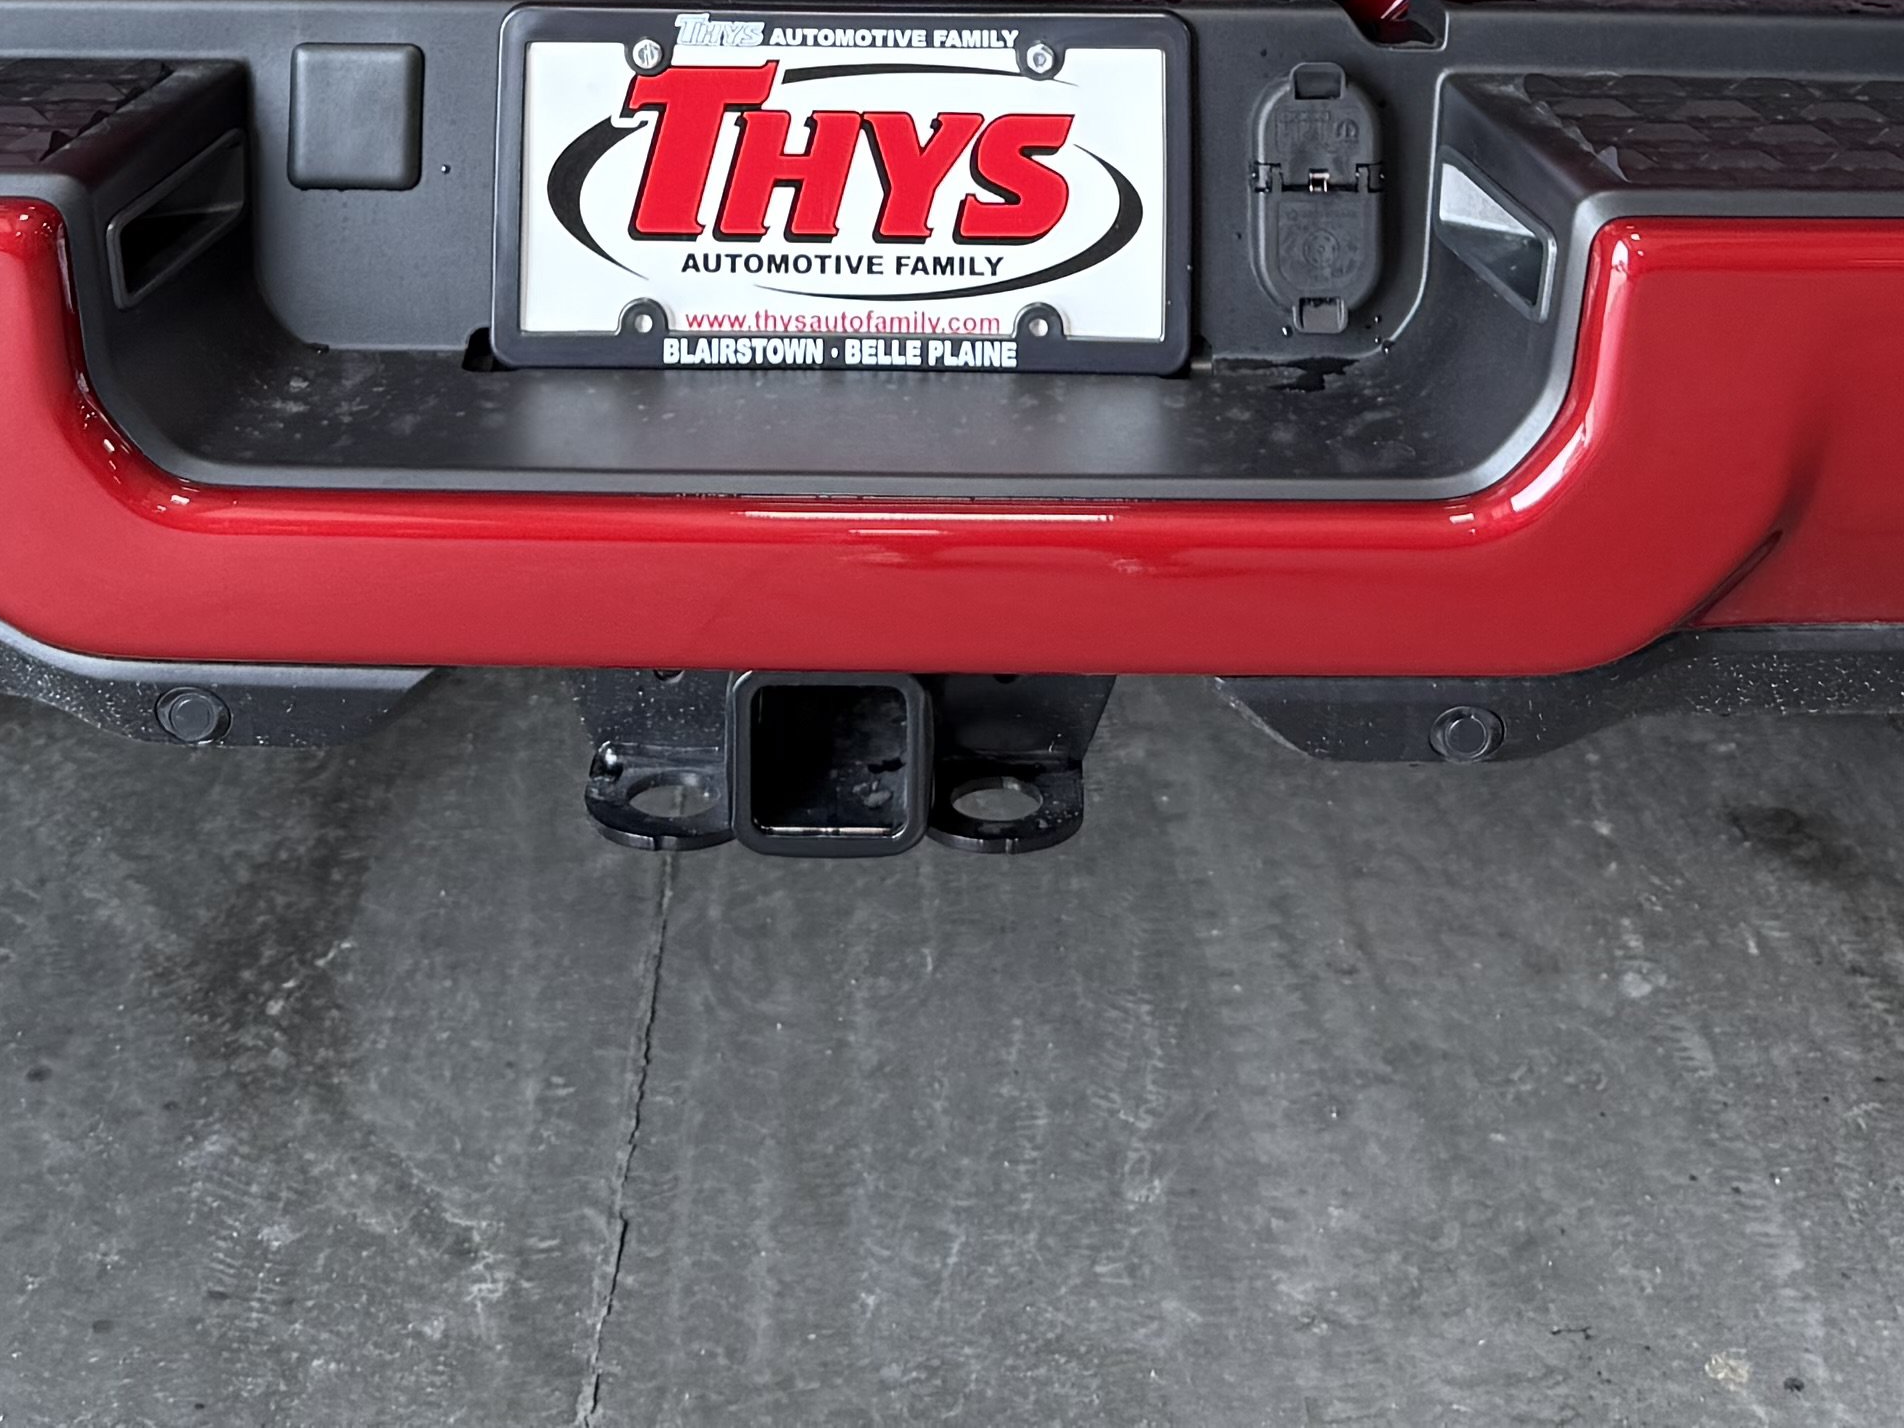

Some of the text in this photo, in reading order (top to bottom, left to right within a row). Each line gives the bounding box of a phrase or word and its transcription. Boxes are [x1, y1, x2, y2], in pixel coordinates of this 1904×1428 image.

[674, 13, 1019, 48] THYS AUTOMOTIVE FAMILY
[627, 59, 1076, 245] THYS
[681, 253, 1004, 277] AUTOMOTIVE FAMILY
[685, 309, 1001, 335] www.thysautofamily.com
[662, 337, 1018, 367] BLAIRSTOWN BELLE PLAINE
